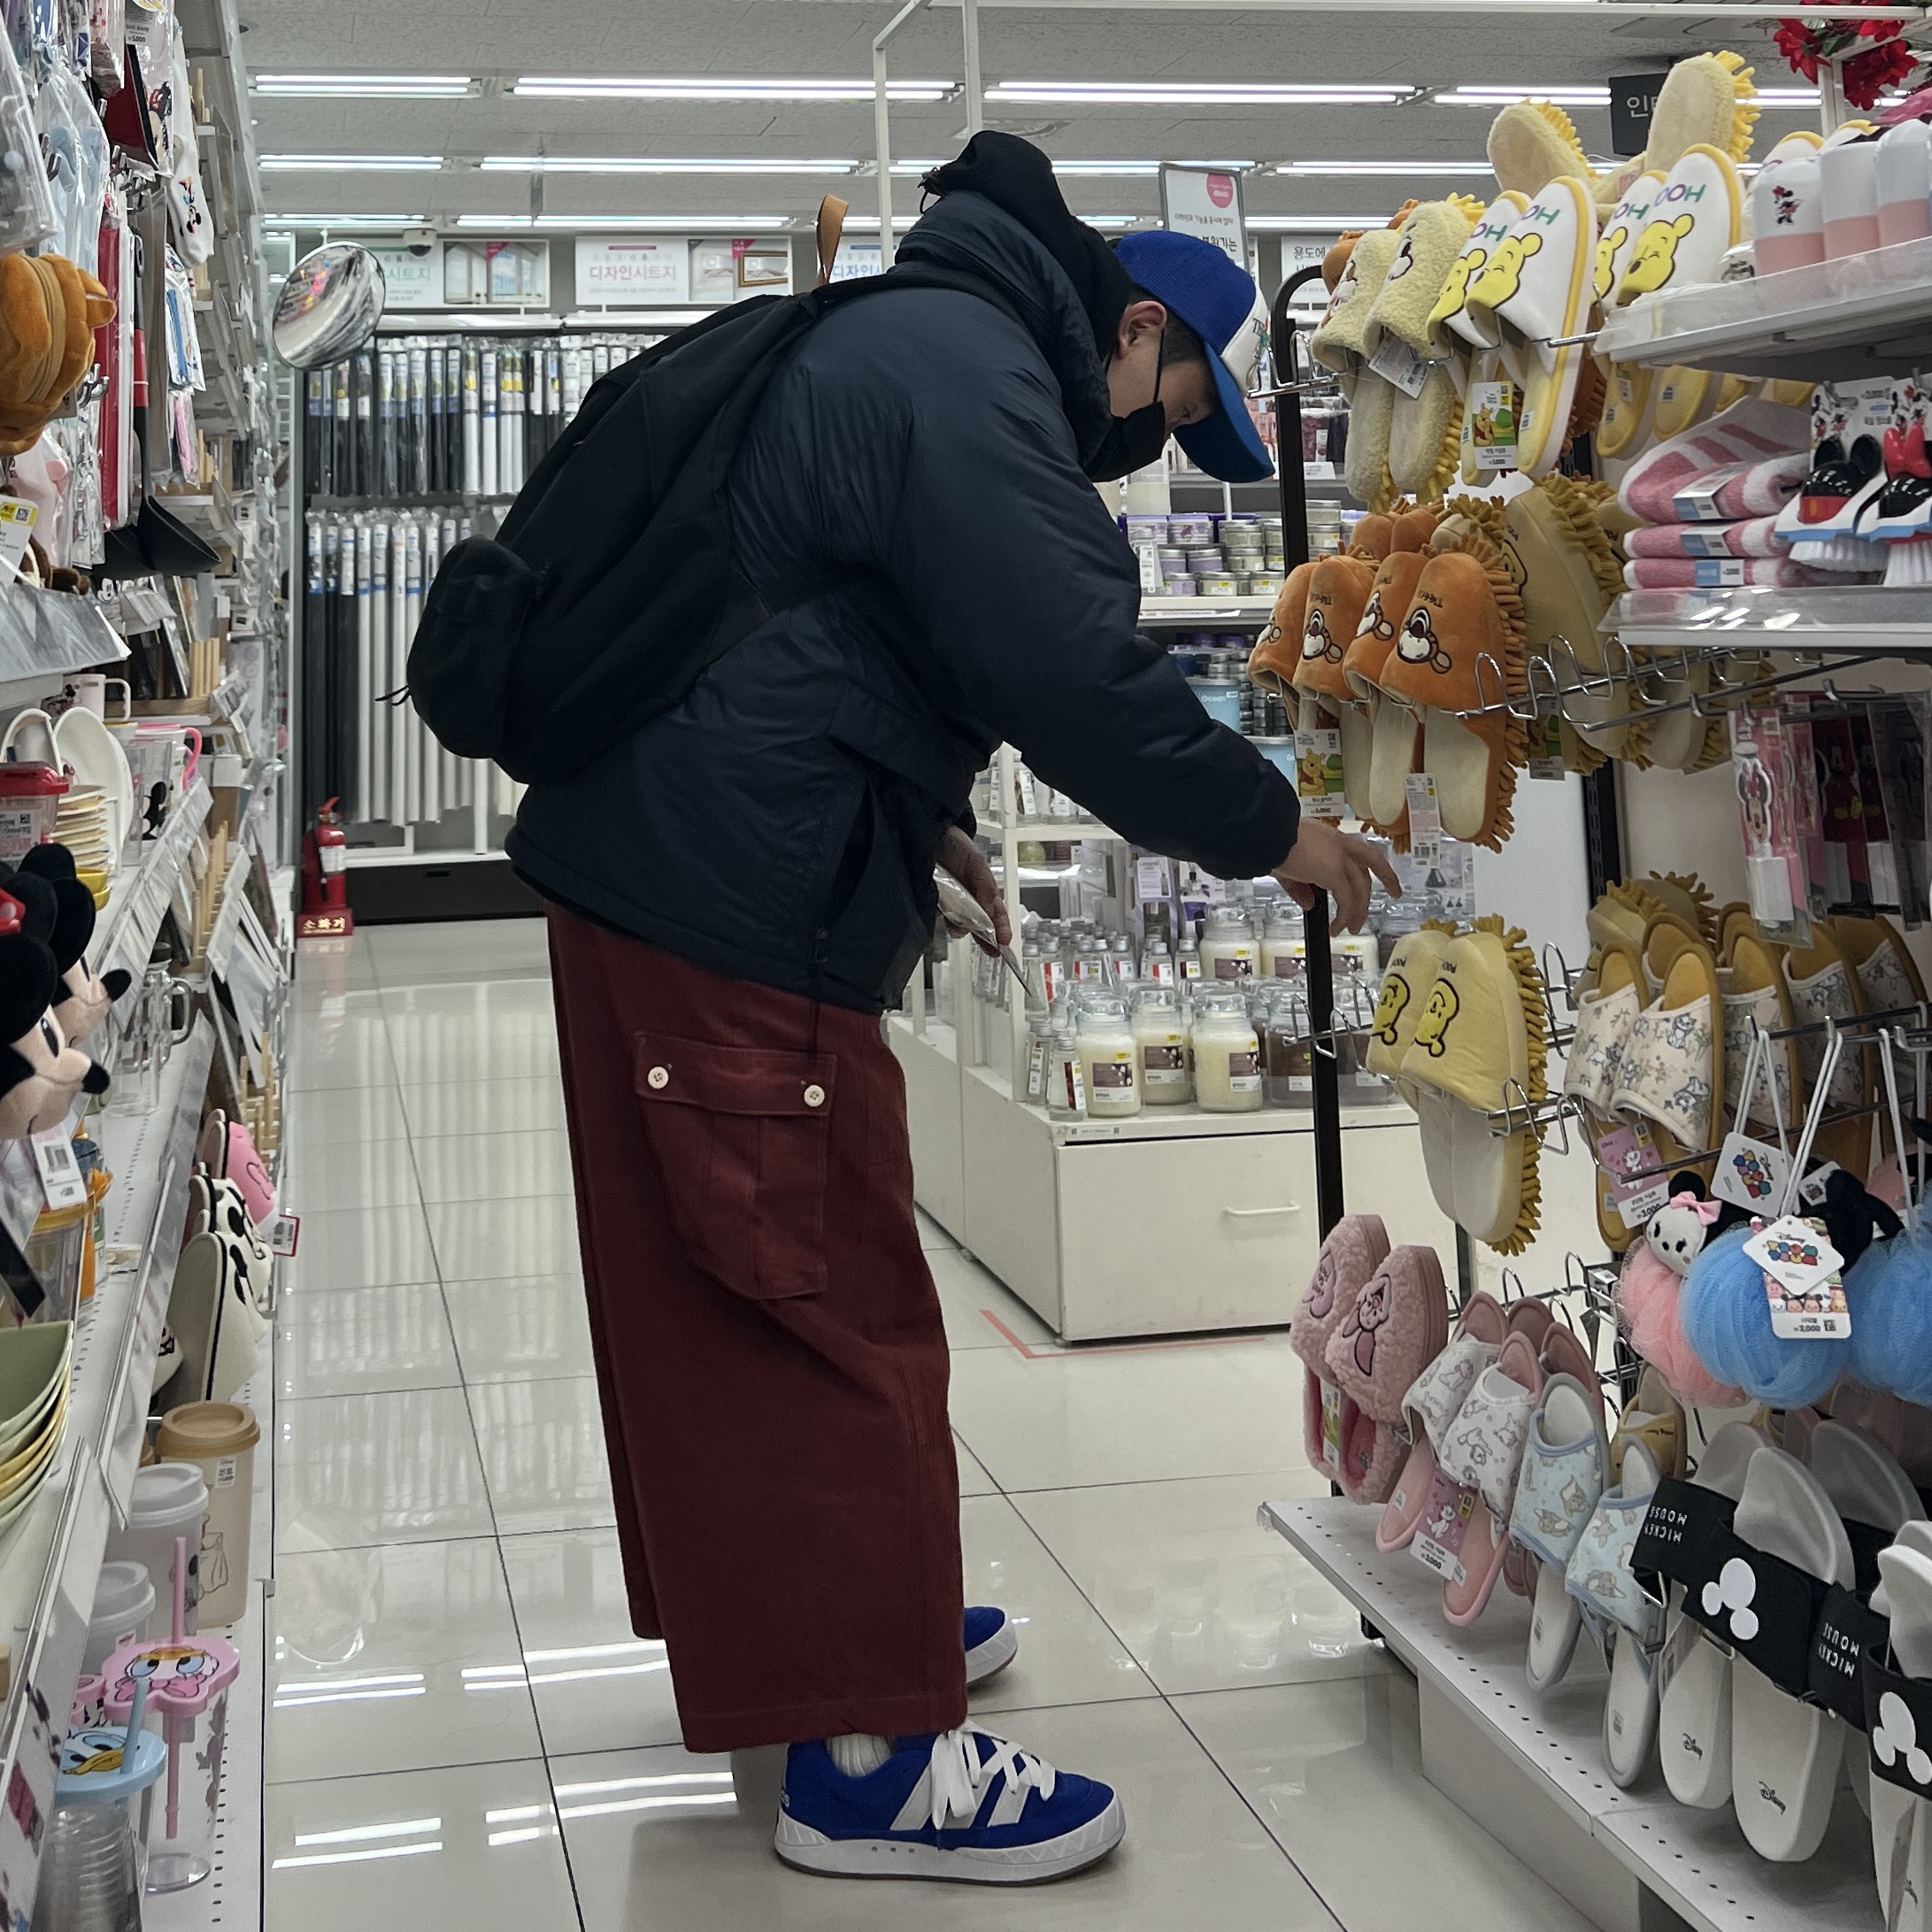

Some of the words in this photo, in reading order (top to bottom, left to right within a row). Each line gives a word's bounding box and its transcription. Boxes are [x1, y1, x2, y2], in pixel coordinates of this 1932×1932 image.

[1654, 183, 1706, 206] OOH
[1294, 245, 1326, 260] 용도에
[384, 266, 431, 282] 시트지
[589, 265, 676, 281] 디자인시트지
